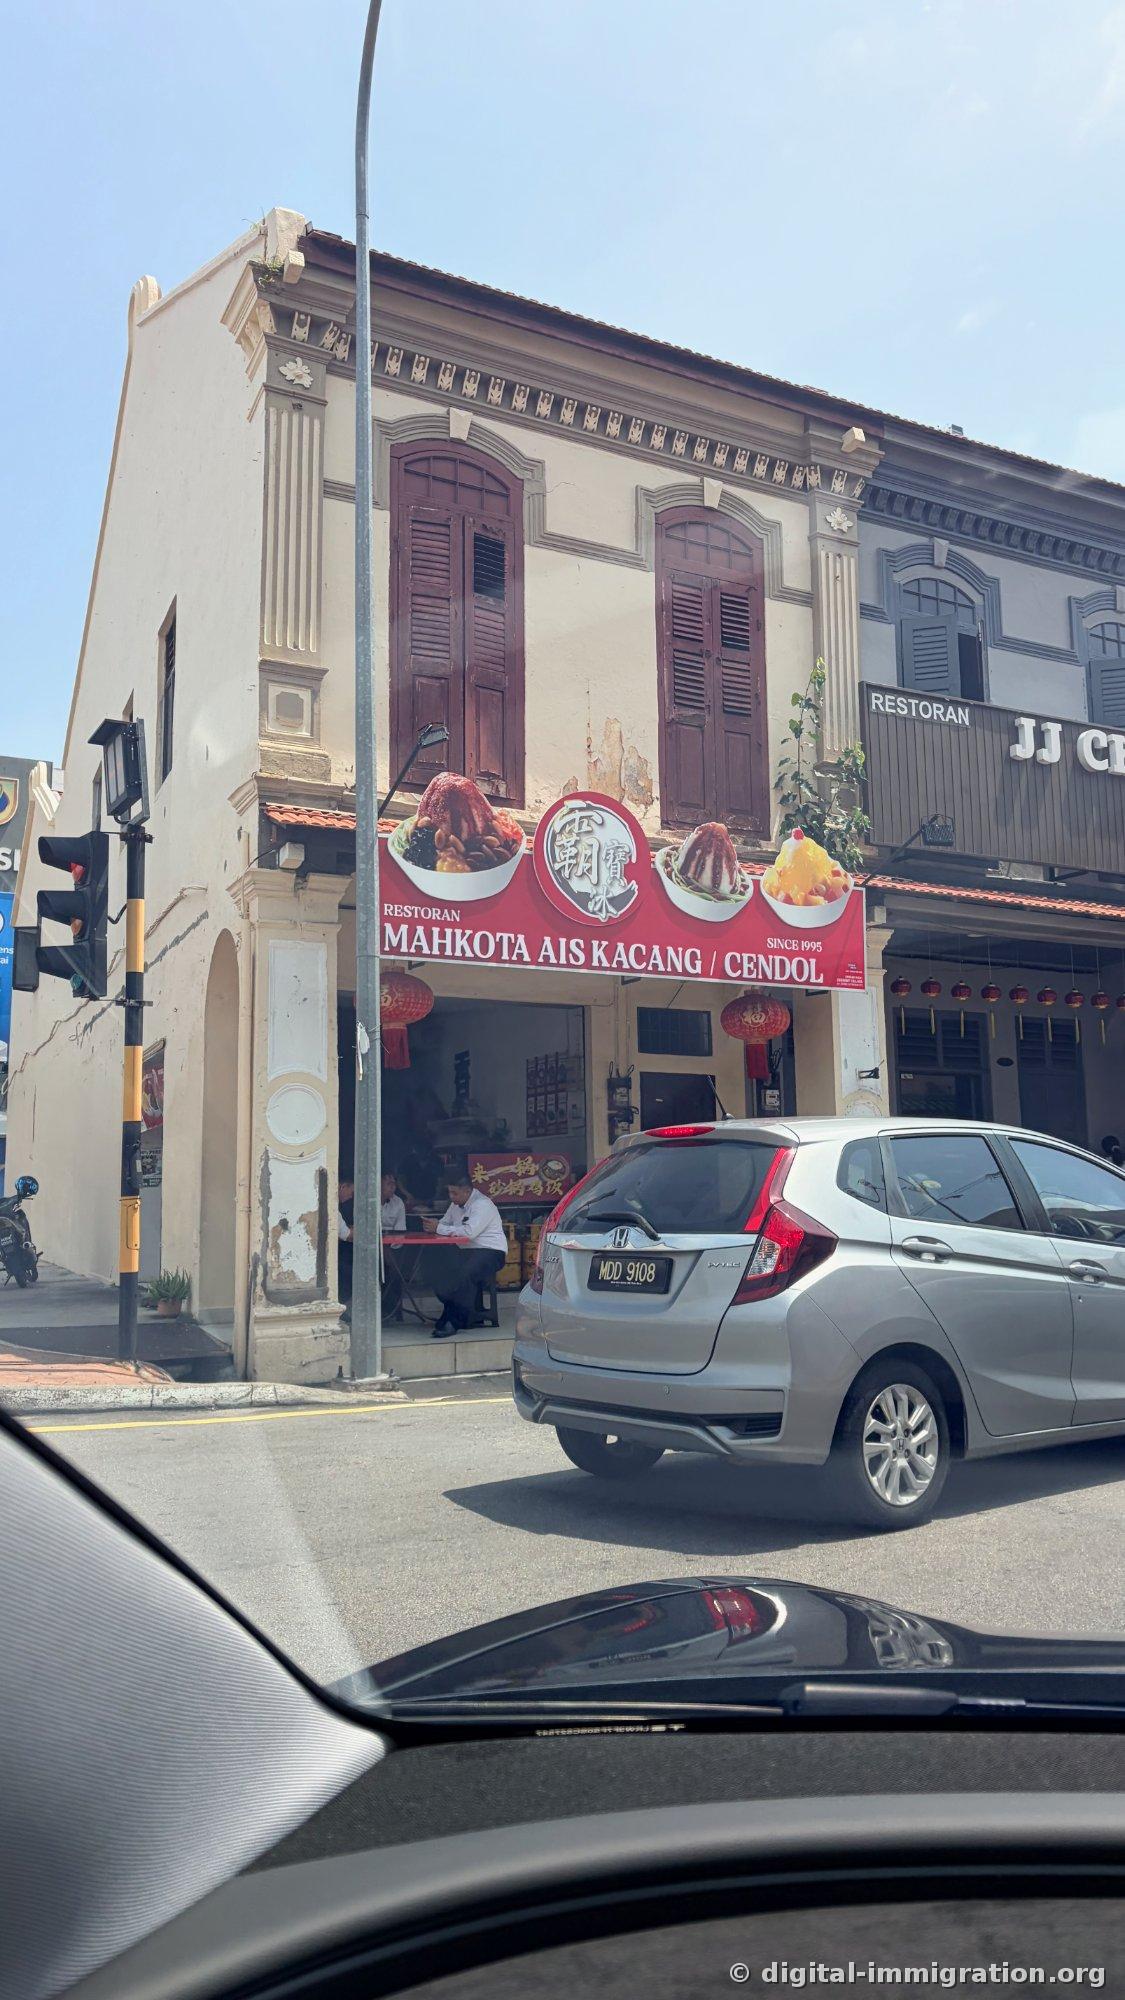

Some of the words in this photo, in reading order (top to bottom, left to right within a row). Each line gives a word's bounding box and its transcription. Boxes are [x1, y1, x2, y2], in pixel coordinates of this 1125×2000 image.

[871, 692, 970, 726] RESTORAN
[1009, 716, 1064, 765] JJ
[383, 903, 461, 922] RESTORAN
[383, 922, 532, 962] MAHKOTA
[537, 935, 586, 966] AIS
[591, 940, 702, 975] KACANG
[709, 950, 717, 976] /
[724, 951, 824, 984] CENDOL
[766, 937, 799, 951] SINCE
[801, 940, 823, 953] 1995
[598, 1260, 623, 1280] MDD
[626, 1261, 656, 1283] 9108
